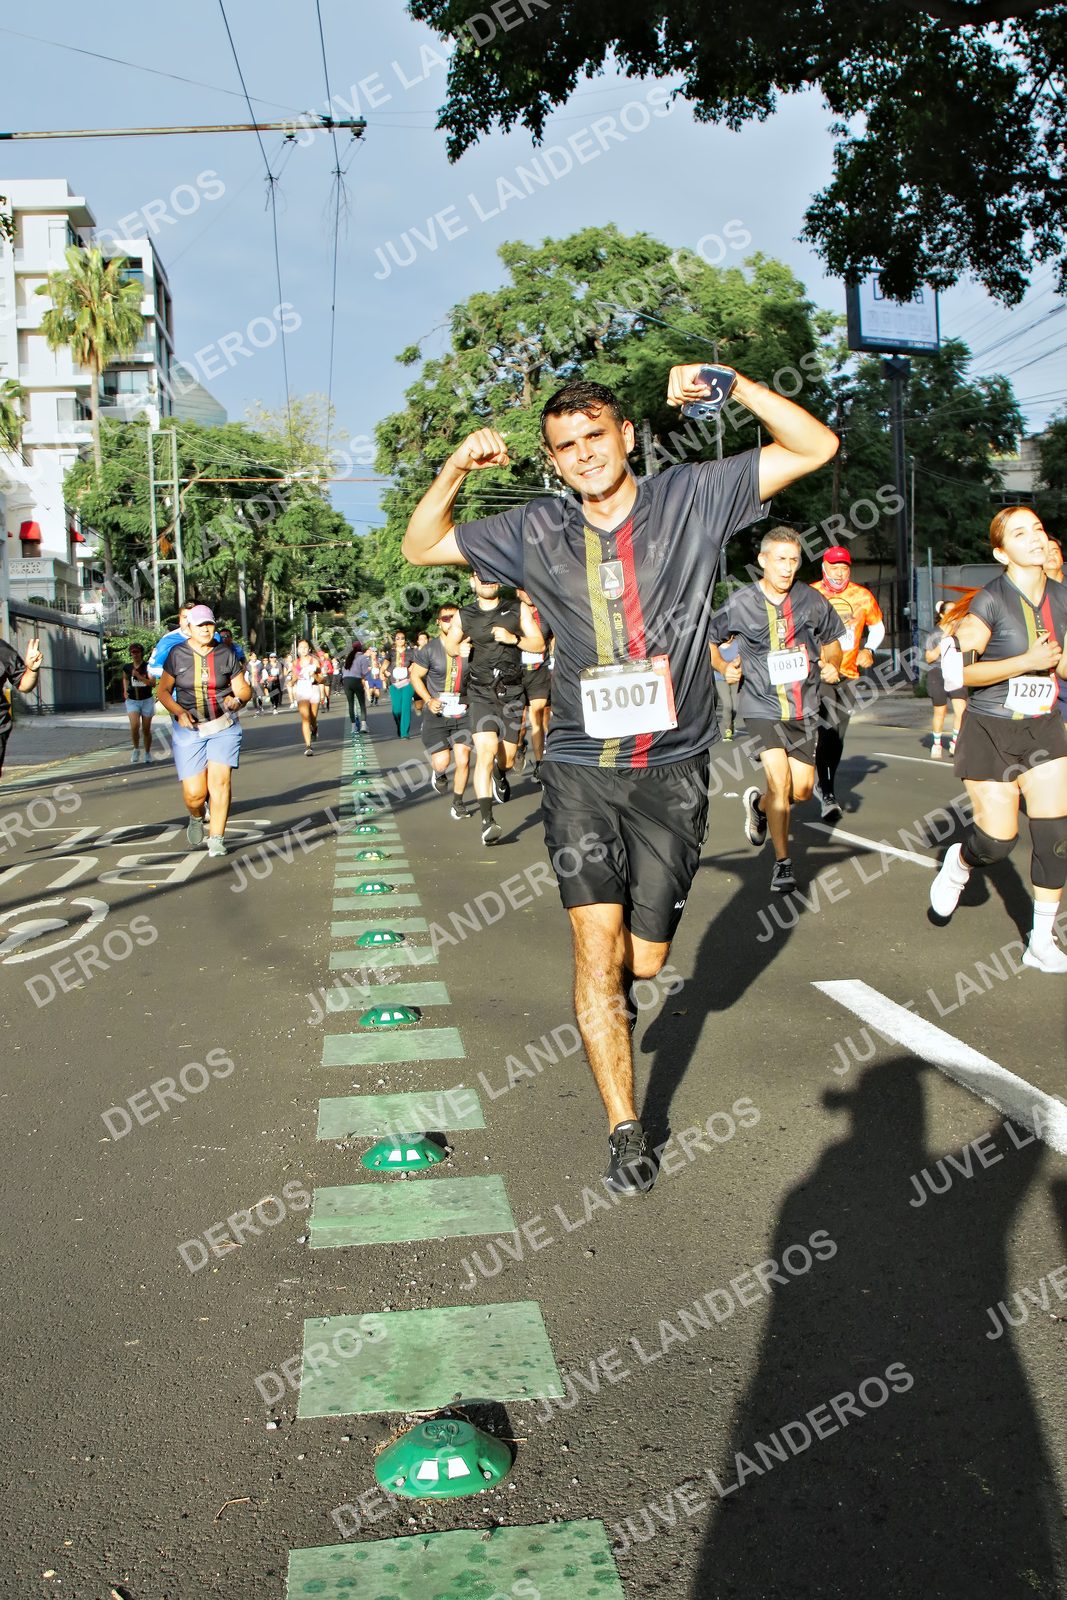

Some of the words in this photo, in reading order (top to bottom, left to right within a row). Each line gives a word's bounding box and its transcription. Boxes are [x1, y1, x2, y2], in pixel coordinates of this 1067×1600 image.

[772, 656, 805, 672] 10812
[586, 680, 659, 712] 13007
[1012, 683, 1053, 698] 12877
